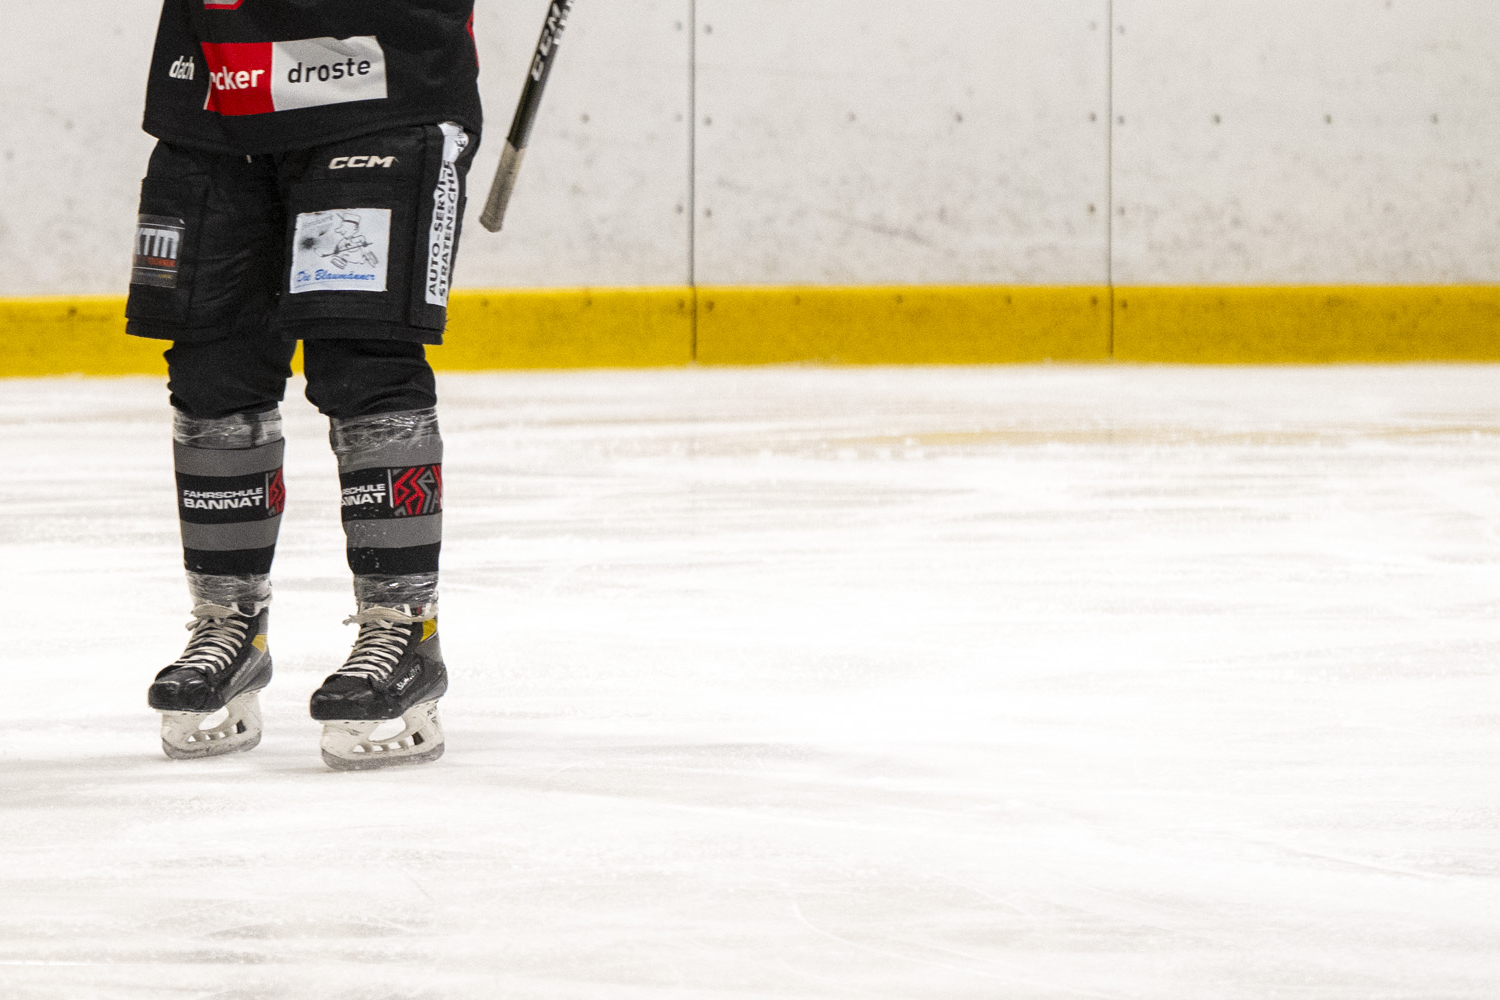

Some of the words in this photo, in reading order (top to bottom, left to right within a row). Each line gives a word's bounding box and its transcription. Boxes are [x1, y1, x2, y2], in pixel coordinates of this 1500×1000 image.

[287, 56, 373, 84] droste
[328, 154, 396, 171] CCM
[183, 487, 265, 500] FAHRSCHULE
[184, 495, 264, 511] BANNAT
